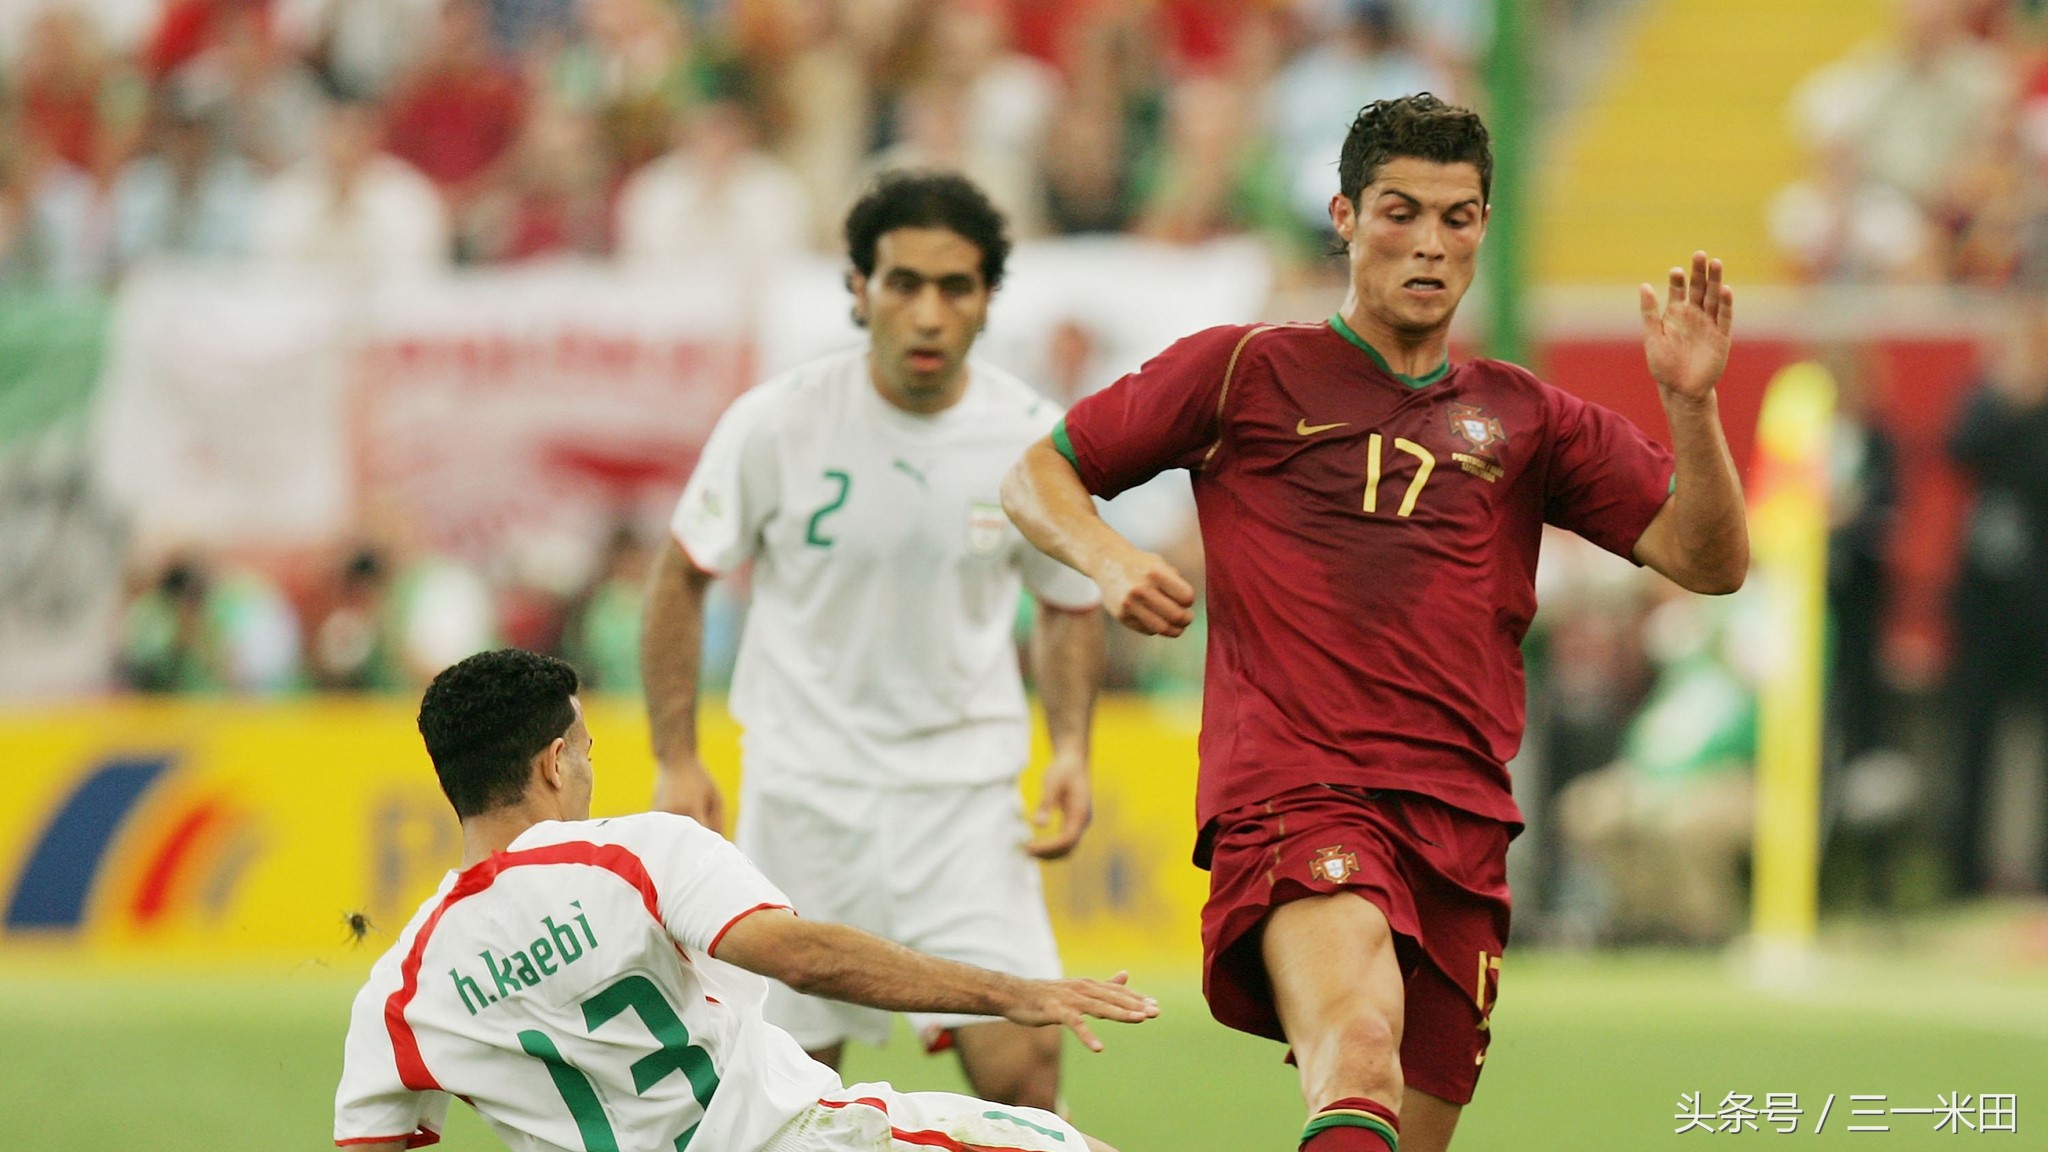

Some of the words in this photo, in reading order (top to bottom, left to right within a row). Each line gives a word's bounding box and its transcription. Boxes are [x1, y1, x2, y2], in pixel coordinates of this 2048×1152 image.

[806, 471, 851, 547] 2
[1363, 433, 1436, 517] 17
[449, 900, 599, 1016] h.kaebi
[517, 974, 721, 1152] 13
